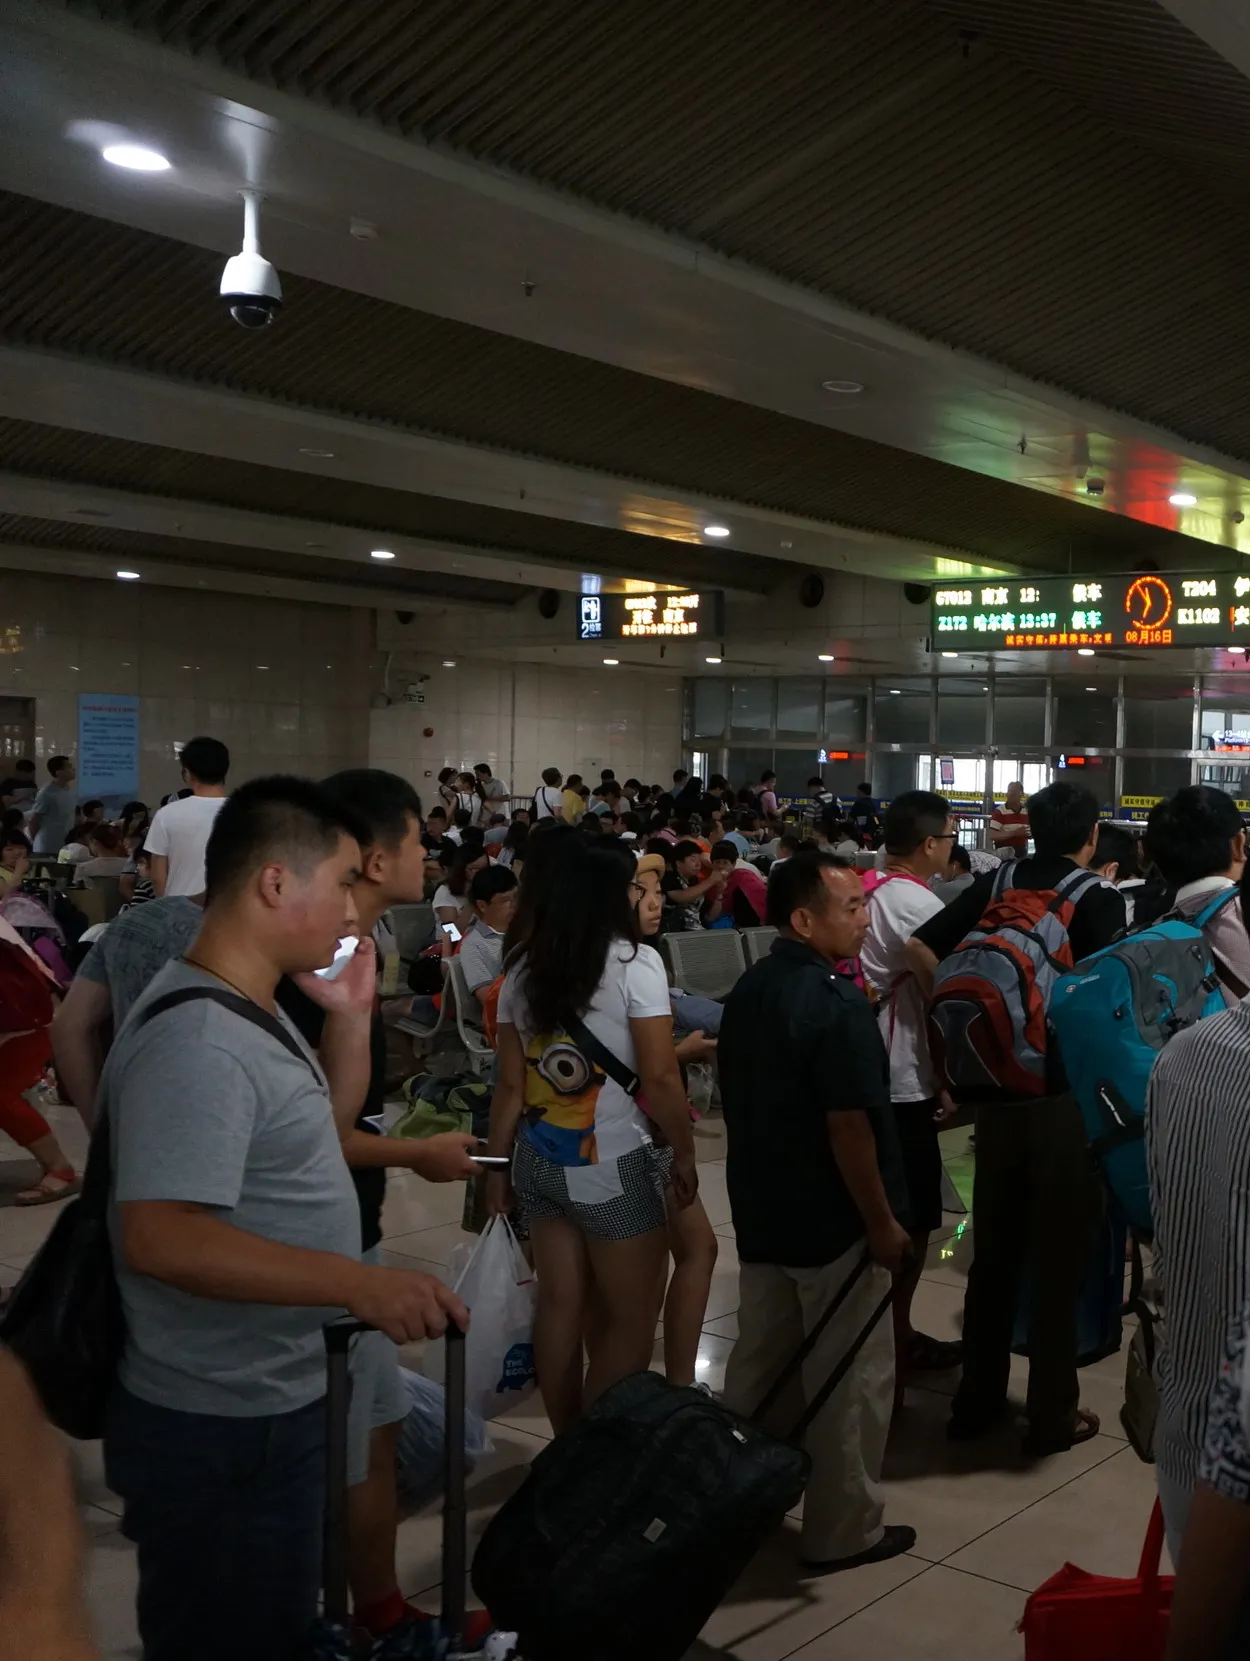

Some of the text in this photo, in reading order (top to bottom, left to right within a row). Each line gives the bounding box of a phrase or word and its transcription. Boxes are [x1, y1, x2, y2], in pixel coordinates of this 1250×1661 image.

[981, 586, 1009, 605] 南京
[1072, 583, 1102, 602] 候车
[1181, 579, 1217, 597] T204
[938, 610, 1102, 632] Z172 哈尔滨 13:37 候车
[1177, 607, 1220, 625] K1102
[1126, 629, 1172, 645] 08月16日
